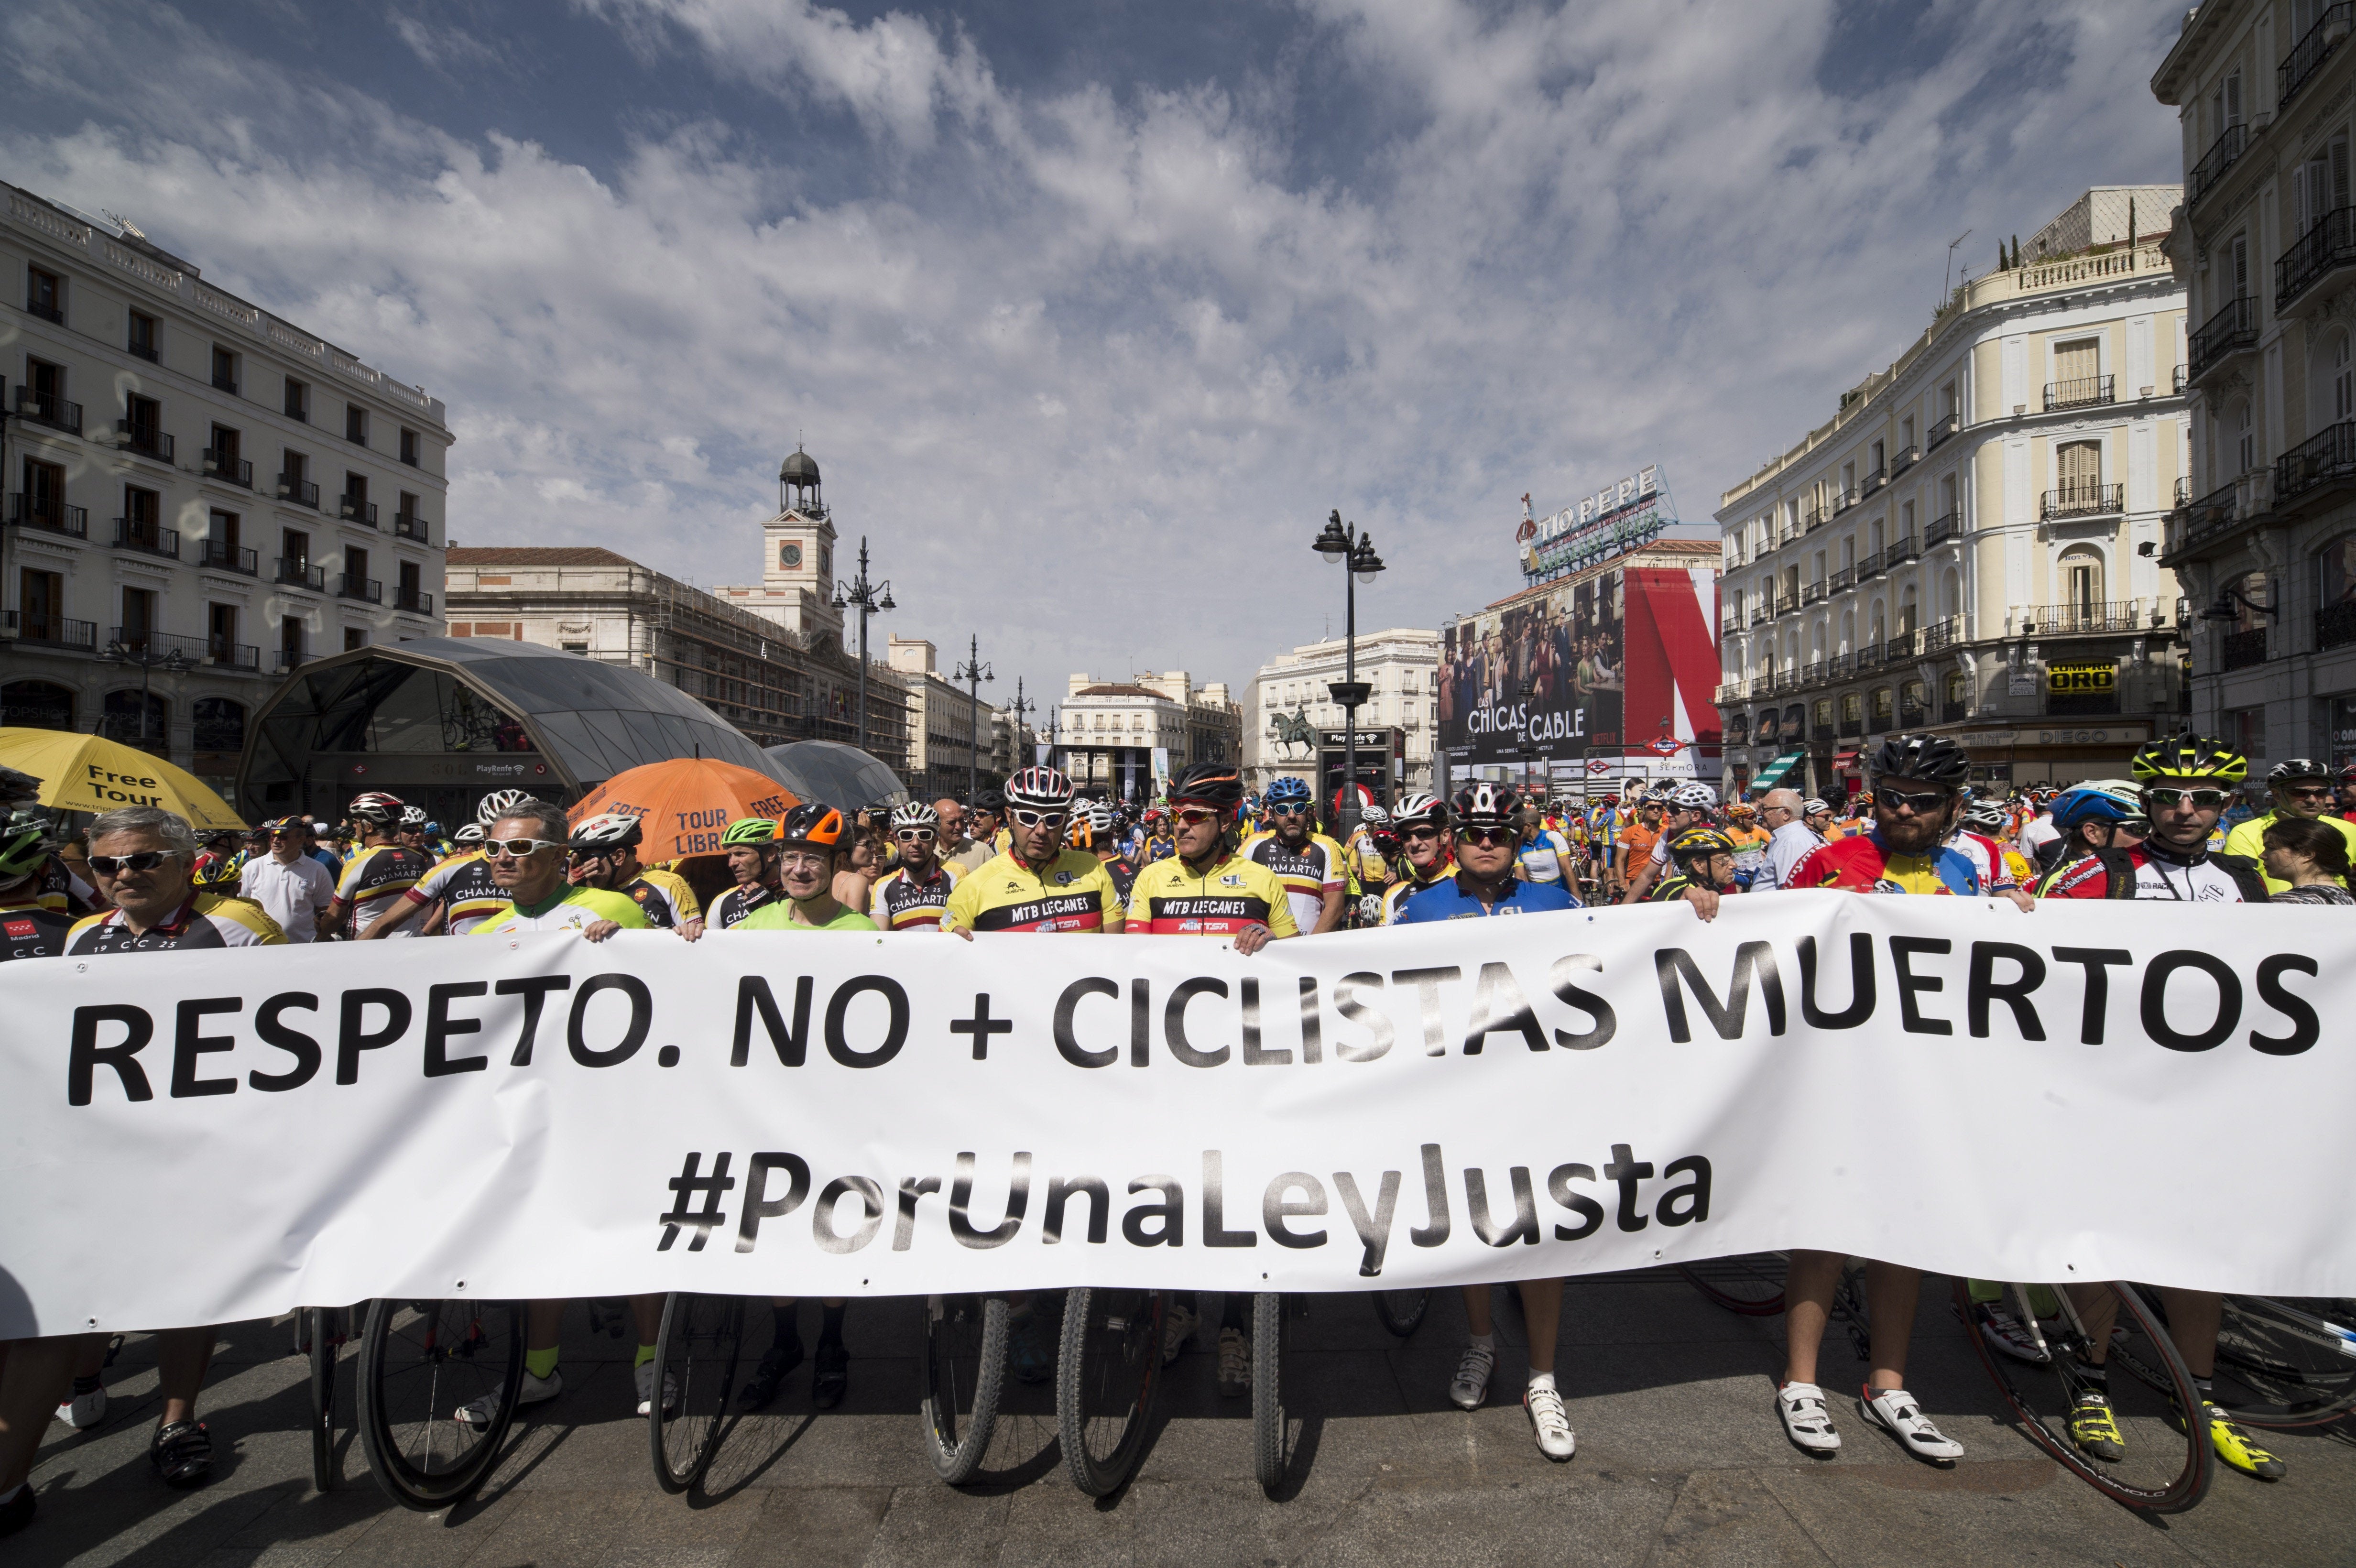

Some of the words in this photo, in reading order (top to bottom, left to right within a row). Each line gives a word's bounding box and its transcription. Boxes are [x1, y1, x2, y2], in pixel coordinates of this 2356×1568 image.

[1539, 508, 1573, 541] TIO
[1580, 464, 1657, 523] PEPE
[2051, 663, 2112, 672] COMPRO
[2051, 671, 2112, 688] ORO
[1478, 697, 1489, 708] LAS
[2, 705, 70, 719] TOPSHOP
[1468, 703, 1527, 733] CHICAS
[1517, 732, 1526, 742] DE
[1530, 708, 1584, 741] CABLE
[1331, 734, 1365, 742] Playnfe
[1592, 732, 1616, 744] NETFLIX
[2040, 730, 2107, 743] DIEGO
[88, 765, 157, 789] Free
[476, 765, 513, 773] PlayRenfe
[2244, 779, 2267, 789] vodafon
[87, 782, 162, 807] Tour
[750, 795, 788, 819] FREE
[676, 808, 729, 830] TOUR
[890, 893, 949, 913] CHAMARTÍ
[1012, 904, 1039, 923] MTB
[1042, 896, 1089, 915] LEGANES
[1163, 900, 1189, 915] MTB
[1191, 900, 1245, 915] LEGANES
[10, 933, 40, 942] Madrid
[13, 948, 26, 958] C
[33, 946, 46, 956] C
[94, 945, 108, 953] 19
[120, 941, 131, 949] C
[158, 940, 177, 948] 25
[68, 973, 680, 1106] RESPETO.
[731, 975, 909, 1068] NO
[950, 993, 1012, 1060] +
[1054, 953, 1616, 1068] CICLISTAS
[1654, 932, 2320, 1056] MUERTOS
[657, 1143, 1713, 1277] #PorUnaLeyJusta
[2290, 1325, 2343, 1346] COLNAGO
[1472, 1351, 1489, 1360] LUCK
